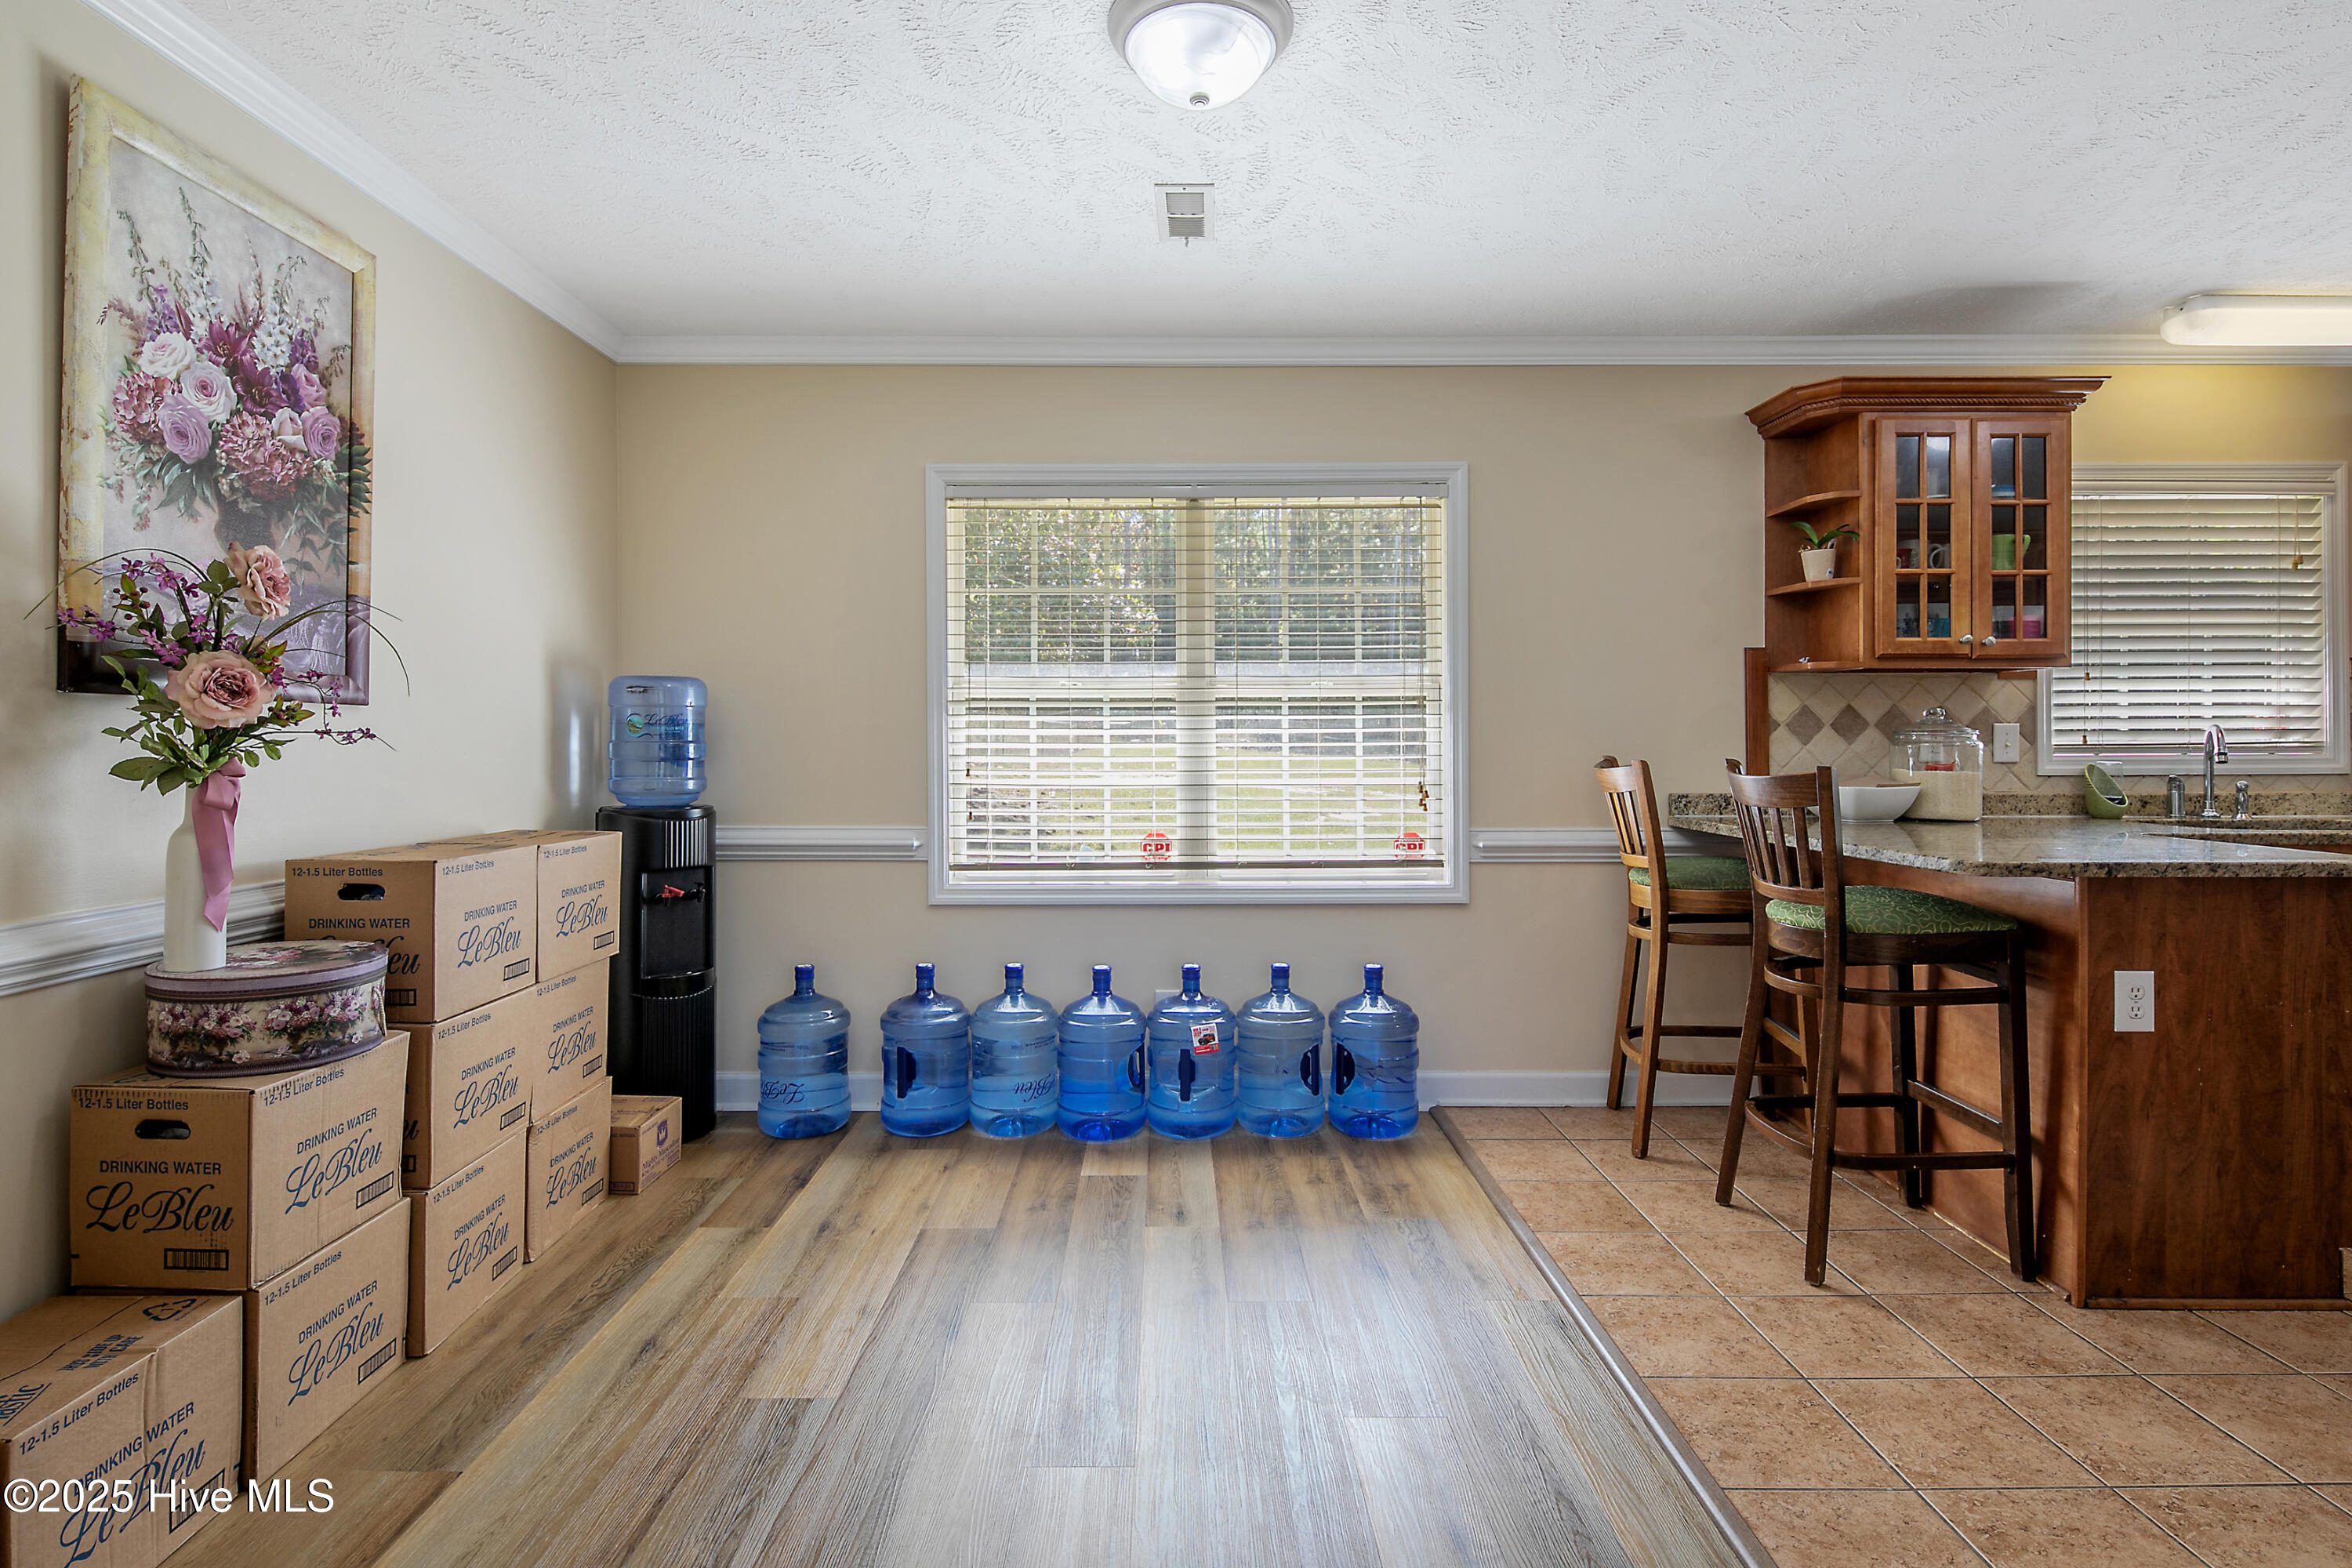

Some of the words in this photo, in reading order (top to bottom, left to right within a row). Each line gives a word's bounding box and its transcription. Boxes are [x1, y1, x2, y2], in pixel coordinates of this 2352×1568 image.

[1142, 843, 1171, 852] CPI
[292, 867, 320, 877] 12-1.5
[322, 867, 347, 877] Liter
[348, 867, 383, 877] Bottles
[442, 865, 459, 876] 12-1.5
[460, 862, 474, 873] Liter
[474, 859, 495, 871] Bottles
[561, 884, 587, 898] DRINKING
[588, 880, 605, 891] WATER
[308, 918, 366, 929] DRINKING
[369, 918, 410, 929] WATER
[464, 905, 495, 922] DRINKING
[496, 900, 517, 914] WATER
[437, 1025, 456, 1040] 12-1.5
[456, 1020, 470, 1033] Liter
[471, 1013, 491, 1027] Bottles
[553, 1014, 577, 1033] DRINKING
[577, 1006, 593, 1021] WATER
[461, 1058, 494, 1081] DRINKING
[495, 1047, 516, 1065] WATER
[263, 1088, 291, 1106] 12-1.5
[293, 1080, 314, 1095] Liter
[315, 1069, 345, 1087] Bottles
[78, 1098, 113, 1109] 12-1.5
[116, 1098, 143, 1109] Liter
[147, 1099, 189, 1110] Bottles
[296, 1123, 344, 1155] DRINKING
[347, 1107, 377, 1131] WATER
[550, 1144, 576, 1168] DRINKING
[576, 1132, 593, 1149] WATER
[100, 1160, 169, 1174] DRINKING
[173, 1161, 222, 1175] WATER
[433, 1188, 451, 1204] 12-1.5
[451, 1178, 464, 1192] Liter
[465, 1165, 485, 1182] Bottles
[454, 1210, 485, 1240] DRINKING
[485, 1194, 506, 1214] WATER
[264, 1283, 290, 1306] 12-1.5
[292, 1269, 312, 1289] Liter
[314, 1251, 342, 1275] Bottles
[299, 1304, 345, 1345] DRINKING
[347, 1280, 378, 1309] WATER
[20, 1421, 60, 1456] 12-1.5
[63, 1400, 93, 1428] Liter
[96, 1373, 140, 1408] Bottles
[72, 1436, 143, 1498] DRINKING
[146, 1401, 194, 1443] WATER
